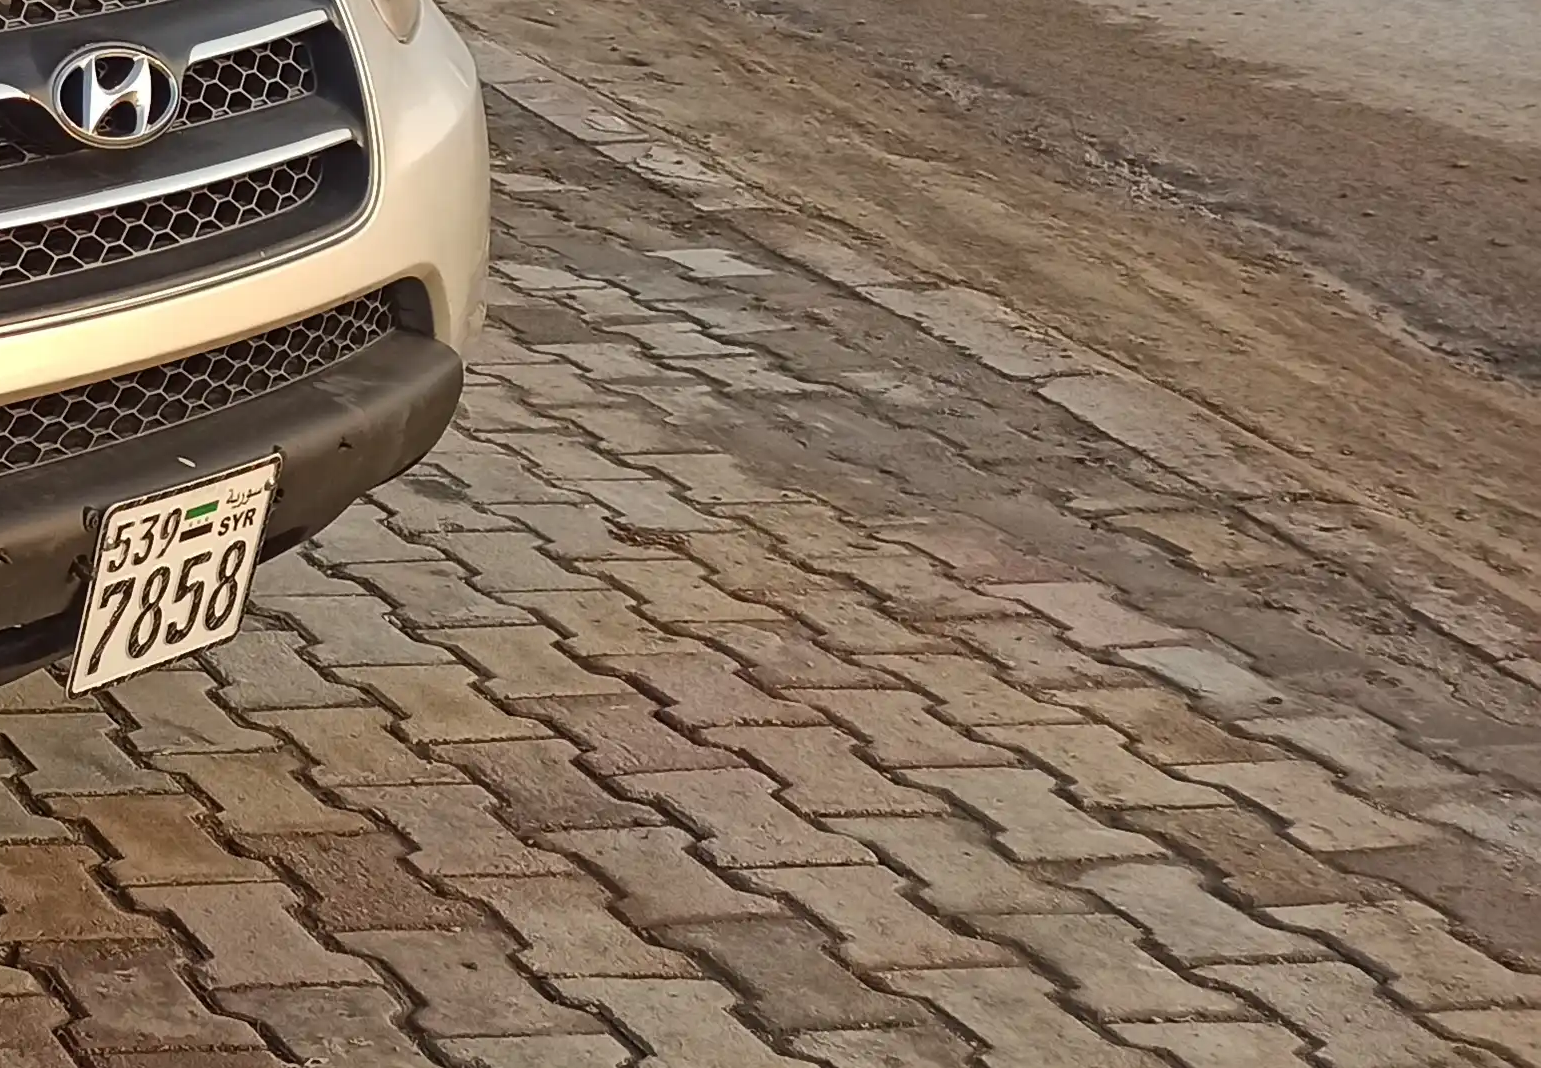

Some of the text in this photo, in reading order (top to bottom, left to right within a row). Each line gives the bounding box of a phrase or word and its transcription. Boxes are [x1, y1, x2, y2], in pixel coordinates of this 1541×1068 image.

[225, 486, 263, 509] سورية
[107, 507, 183, 573] 539
[217, 507, 257, 536] SYR
[87, 539, 247, 676] 7858
